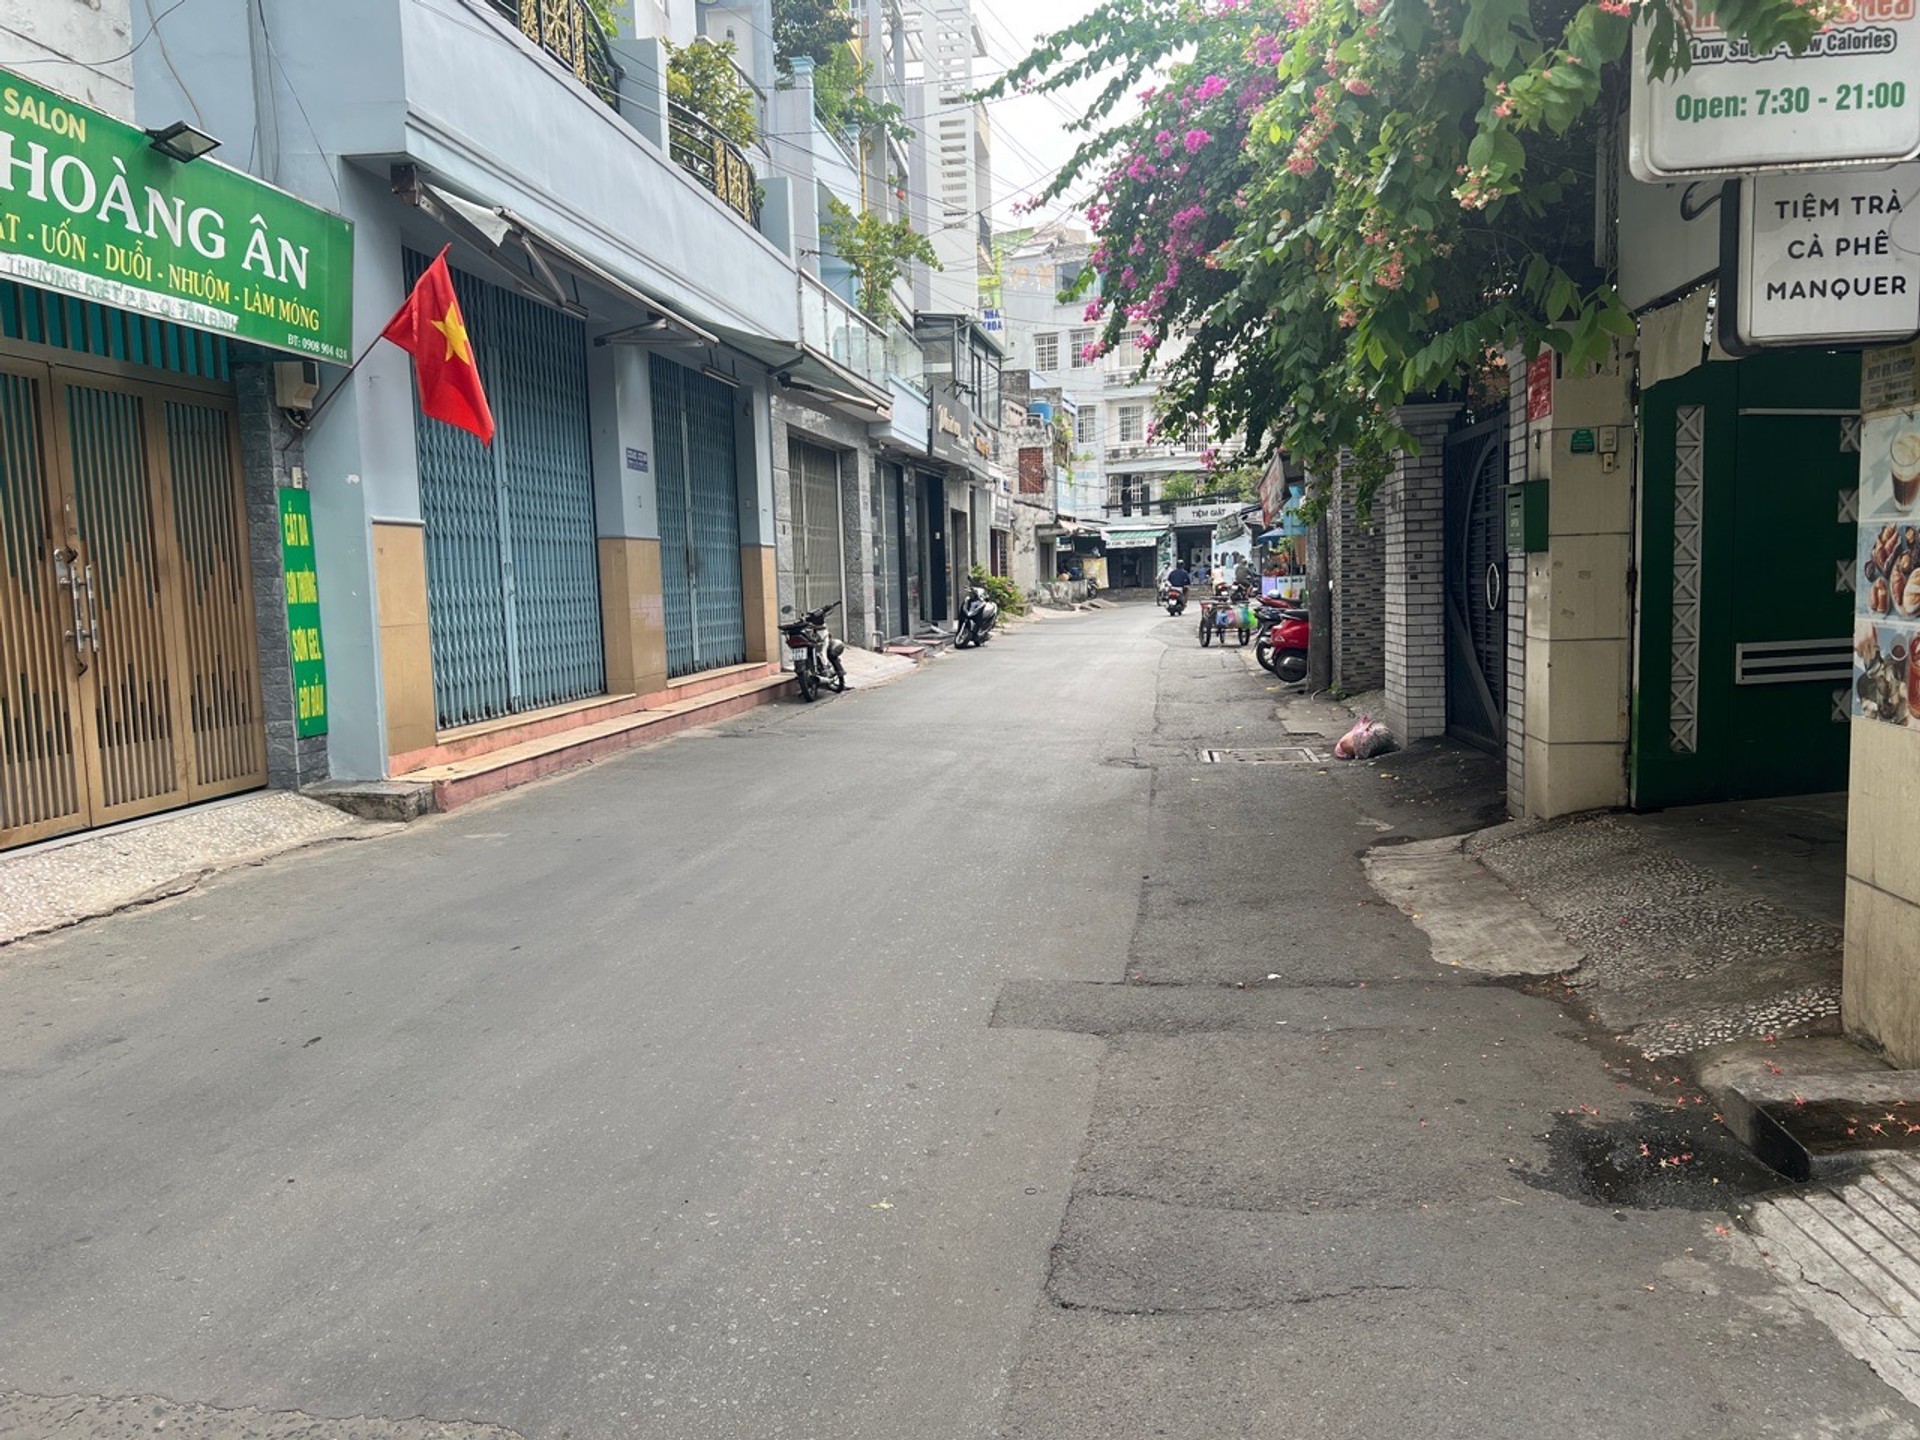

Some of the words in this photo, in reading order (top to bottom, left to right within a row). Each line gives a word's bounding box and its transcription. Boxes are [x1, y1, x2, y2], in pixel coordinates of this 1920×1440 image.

[1692, 42, 1724, 60] Low
[1827, 31, 1893, 51] Calories
[4, 87, 86, 143] SALON
[1675, 93, 1748, 122] Open:
[1755, 86, 1810, 115] 7:30
[1835, 80, 1906, 111] 21:00
[0, 130, 226, 260] HOÀNG
[241, 213, 310, 290] ÂN
[1775, 193, 1839, 222] TIỆM
[1851, 189, 1903, 216] TRÀ
[1788, 233, 1824, 260] CÀ
[1836, 229, 1889, 257] PHÊ
[41, 218, 86, 262] UỐN
[105, 239, 152, 282] DUỖI
[168, 264, 230, 305] NHUỘM
[244, 283, 275, 318] LÀM
[279, 296, 320, 331] MÓNG
[1767, 275, 1906, 301] MANQUER
